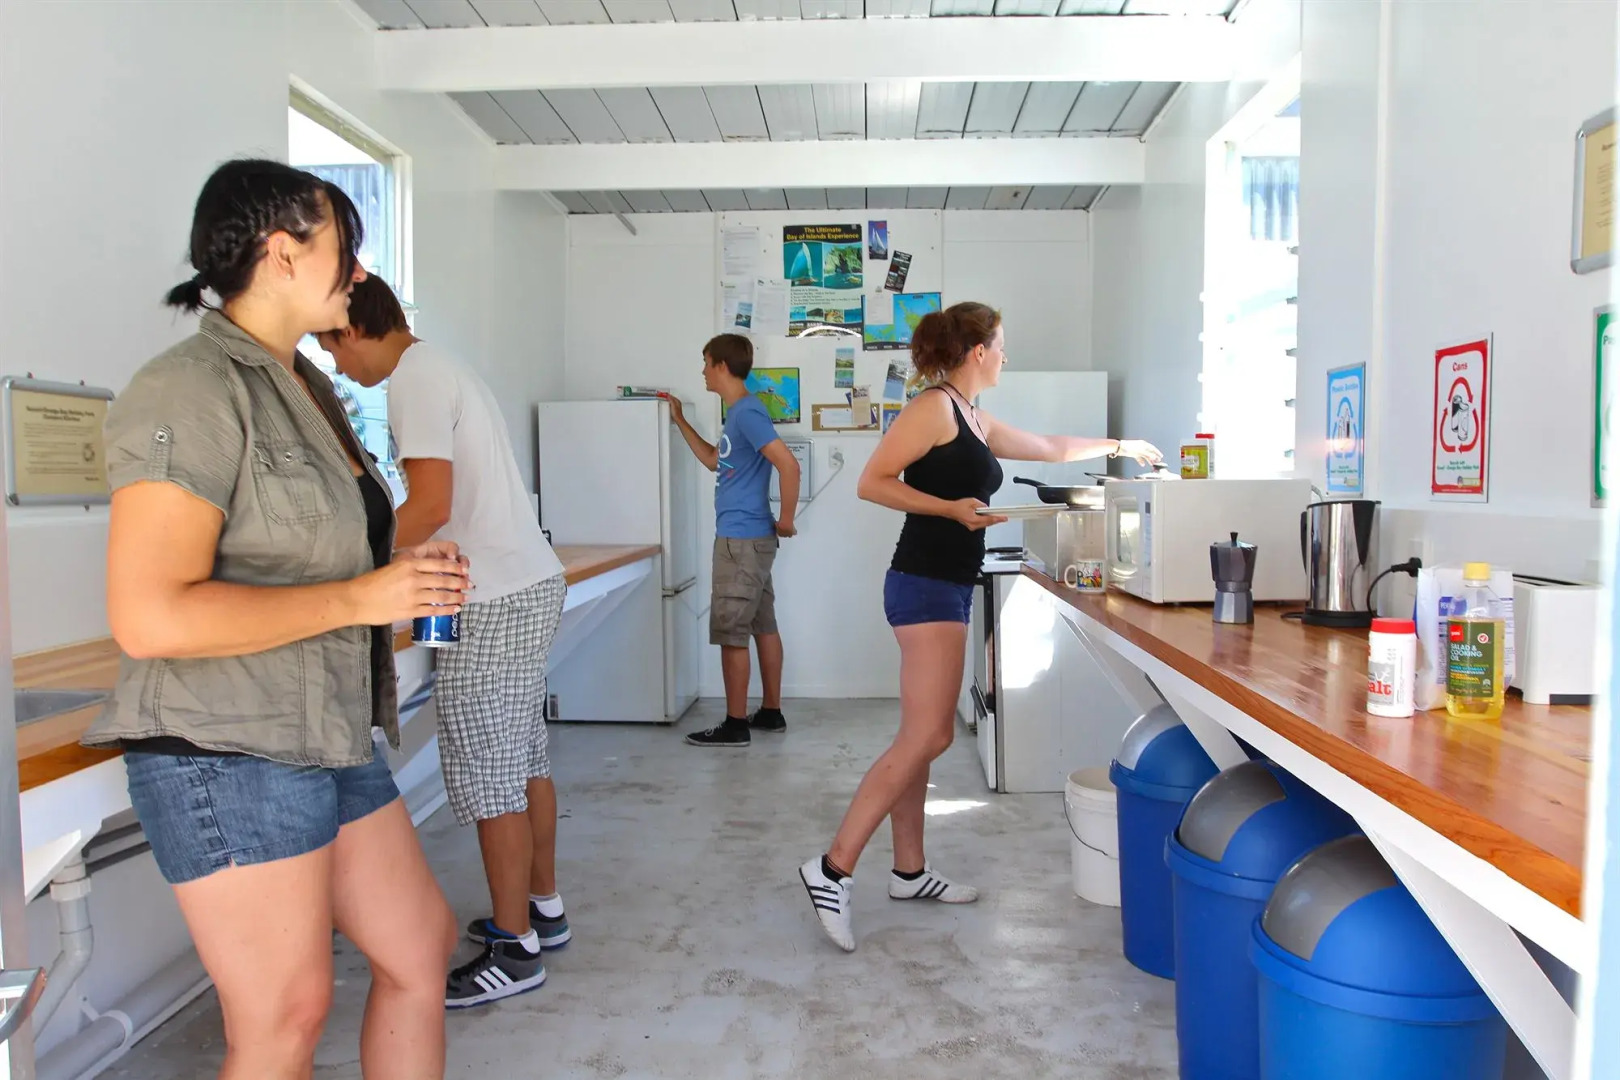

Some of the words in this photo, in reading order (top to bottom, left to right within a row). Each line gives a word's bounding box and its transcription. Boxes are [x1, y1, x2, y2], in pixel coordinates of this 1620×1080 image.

[1453, 362, 1468, 371] Cans
[1450, 643, 1470, 651] SALAD
[1450, 649, 1483, 658] COOKING
[1368, 680, 1392, 696] alt
